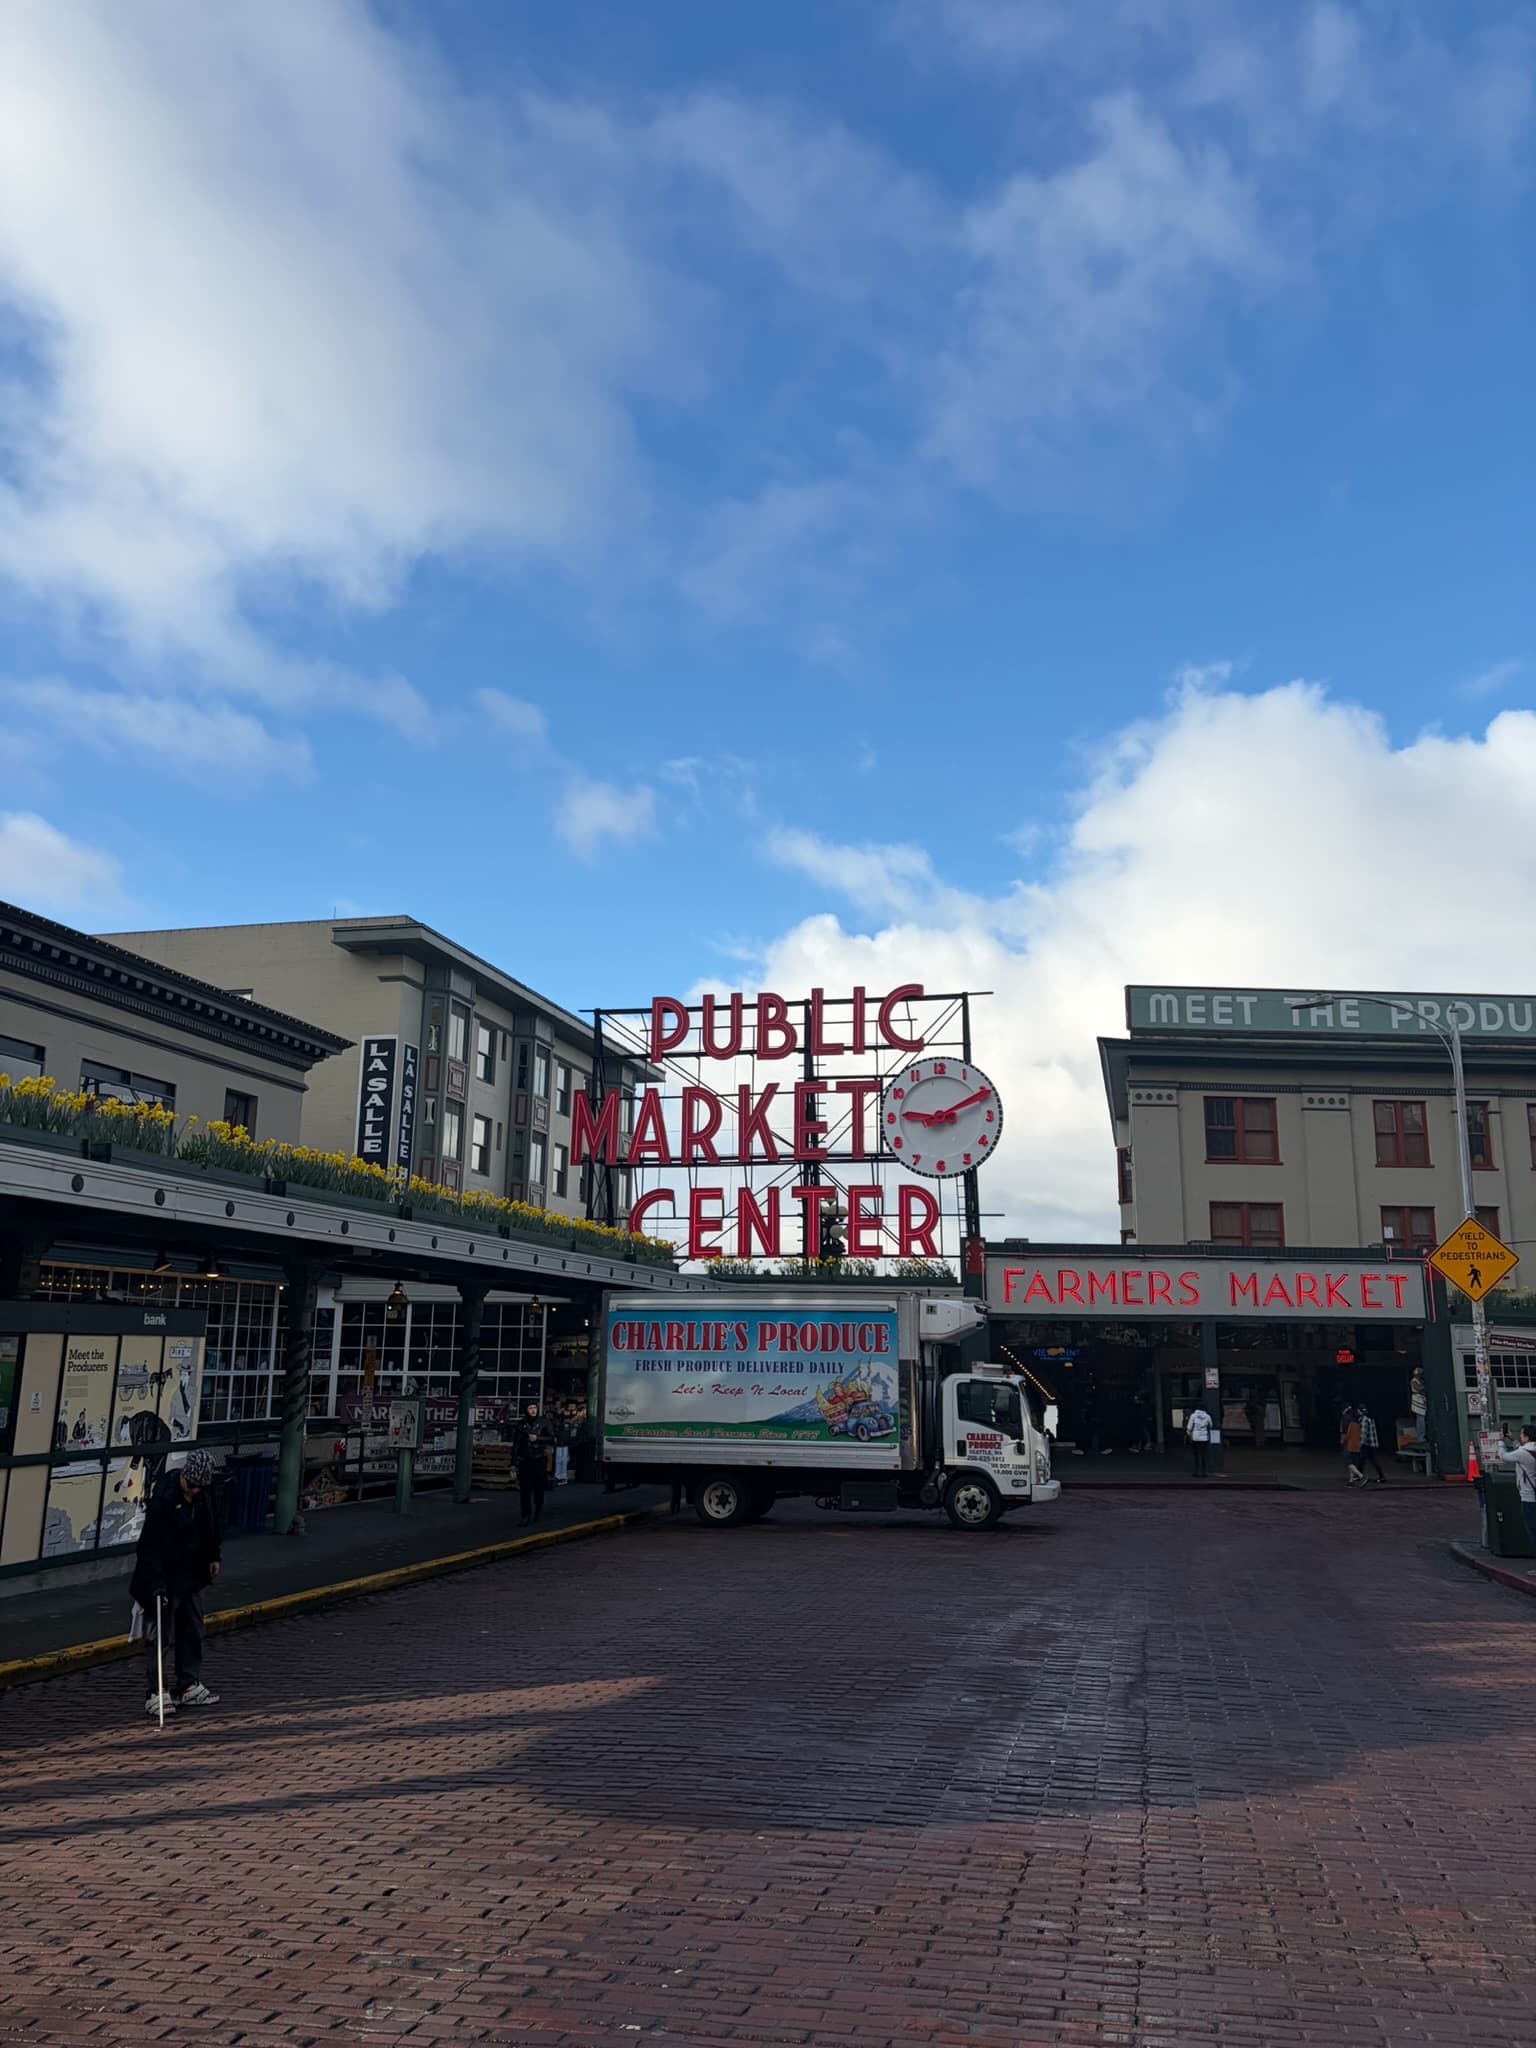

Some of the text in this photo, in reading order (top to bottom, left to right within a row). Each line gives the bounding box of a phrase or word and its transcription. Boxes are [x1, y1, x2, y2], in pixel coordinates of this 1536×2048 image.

[1149, 994, 1533, 1032] MEET THE PRODU
[650, 983, 925, 1064] PUBLIC
[405, 1047, 416, 1078] LA
[934, 1062, 946, 1075] 12
[910, 1070, 920, 1082] 11
[962, 1068, 967, 1080] 1
[363, 1043, 388, 1153] LA SALLE
[893, 1088, 904, 1100] 10
[400, 1085, 413, 1159] SALLE
[887, 1112, 896, 1124] 9
[986, 1109, 994, 1122] 3
[570, 1080, 881, 1167] MARKET
[893, 1136, 903, 1149] 8
[978, 1134, 989, 1147] 4
[912, 1154, 922, 1166] 7
[936, 1160, 946, 1172] 6
[963, 1153, 971, 1166] 5
[628, 1184, 940, 1259] CENTER
[1458, 1232, 1485, 1241] YIELD
[1467, 1242, 1478, 1250] TO
[1440, 1251, 1506, 1261] PEDESTRIANS
[1003, 1267, 1409, 1308] FARMERS MARKET
[143, 1312, 167, 1326] bank
[611, 1320, 890, 1353] CHARLIE'S PRODUCE
[68, 1349, 105, 1360] Meet the
[67, 1361, 108, 1373] Producers
[635, 1360, 845, 1375] FRESH PRODUCE DELIVERED DAILY
[672, 1383, 704, 1395] Let's
[711, 1384, 744, 1397] Keep
[767, 1385, 808, 1397] Local
